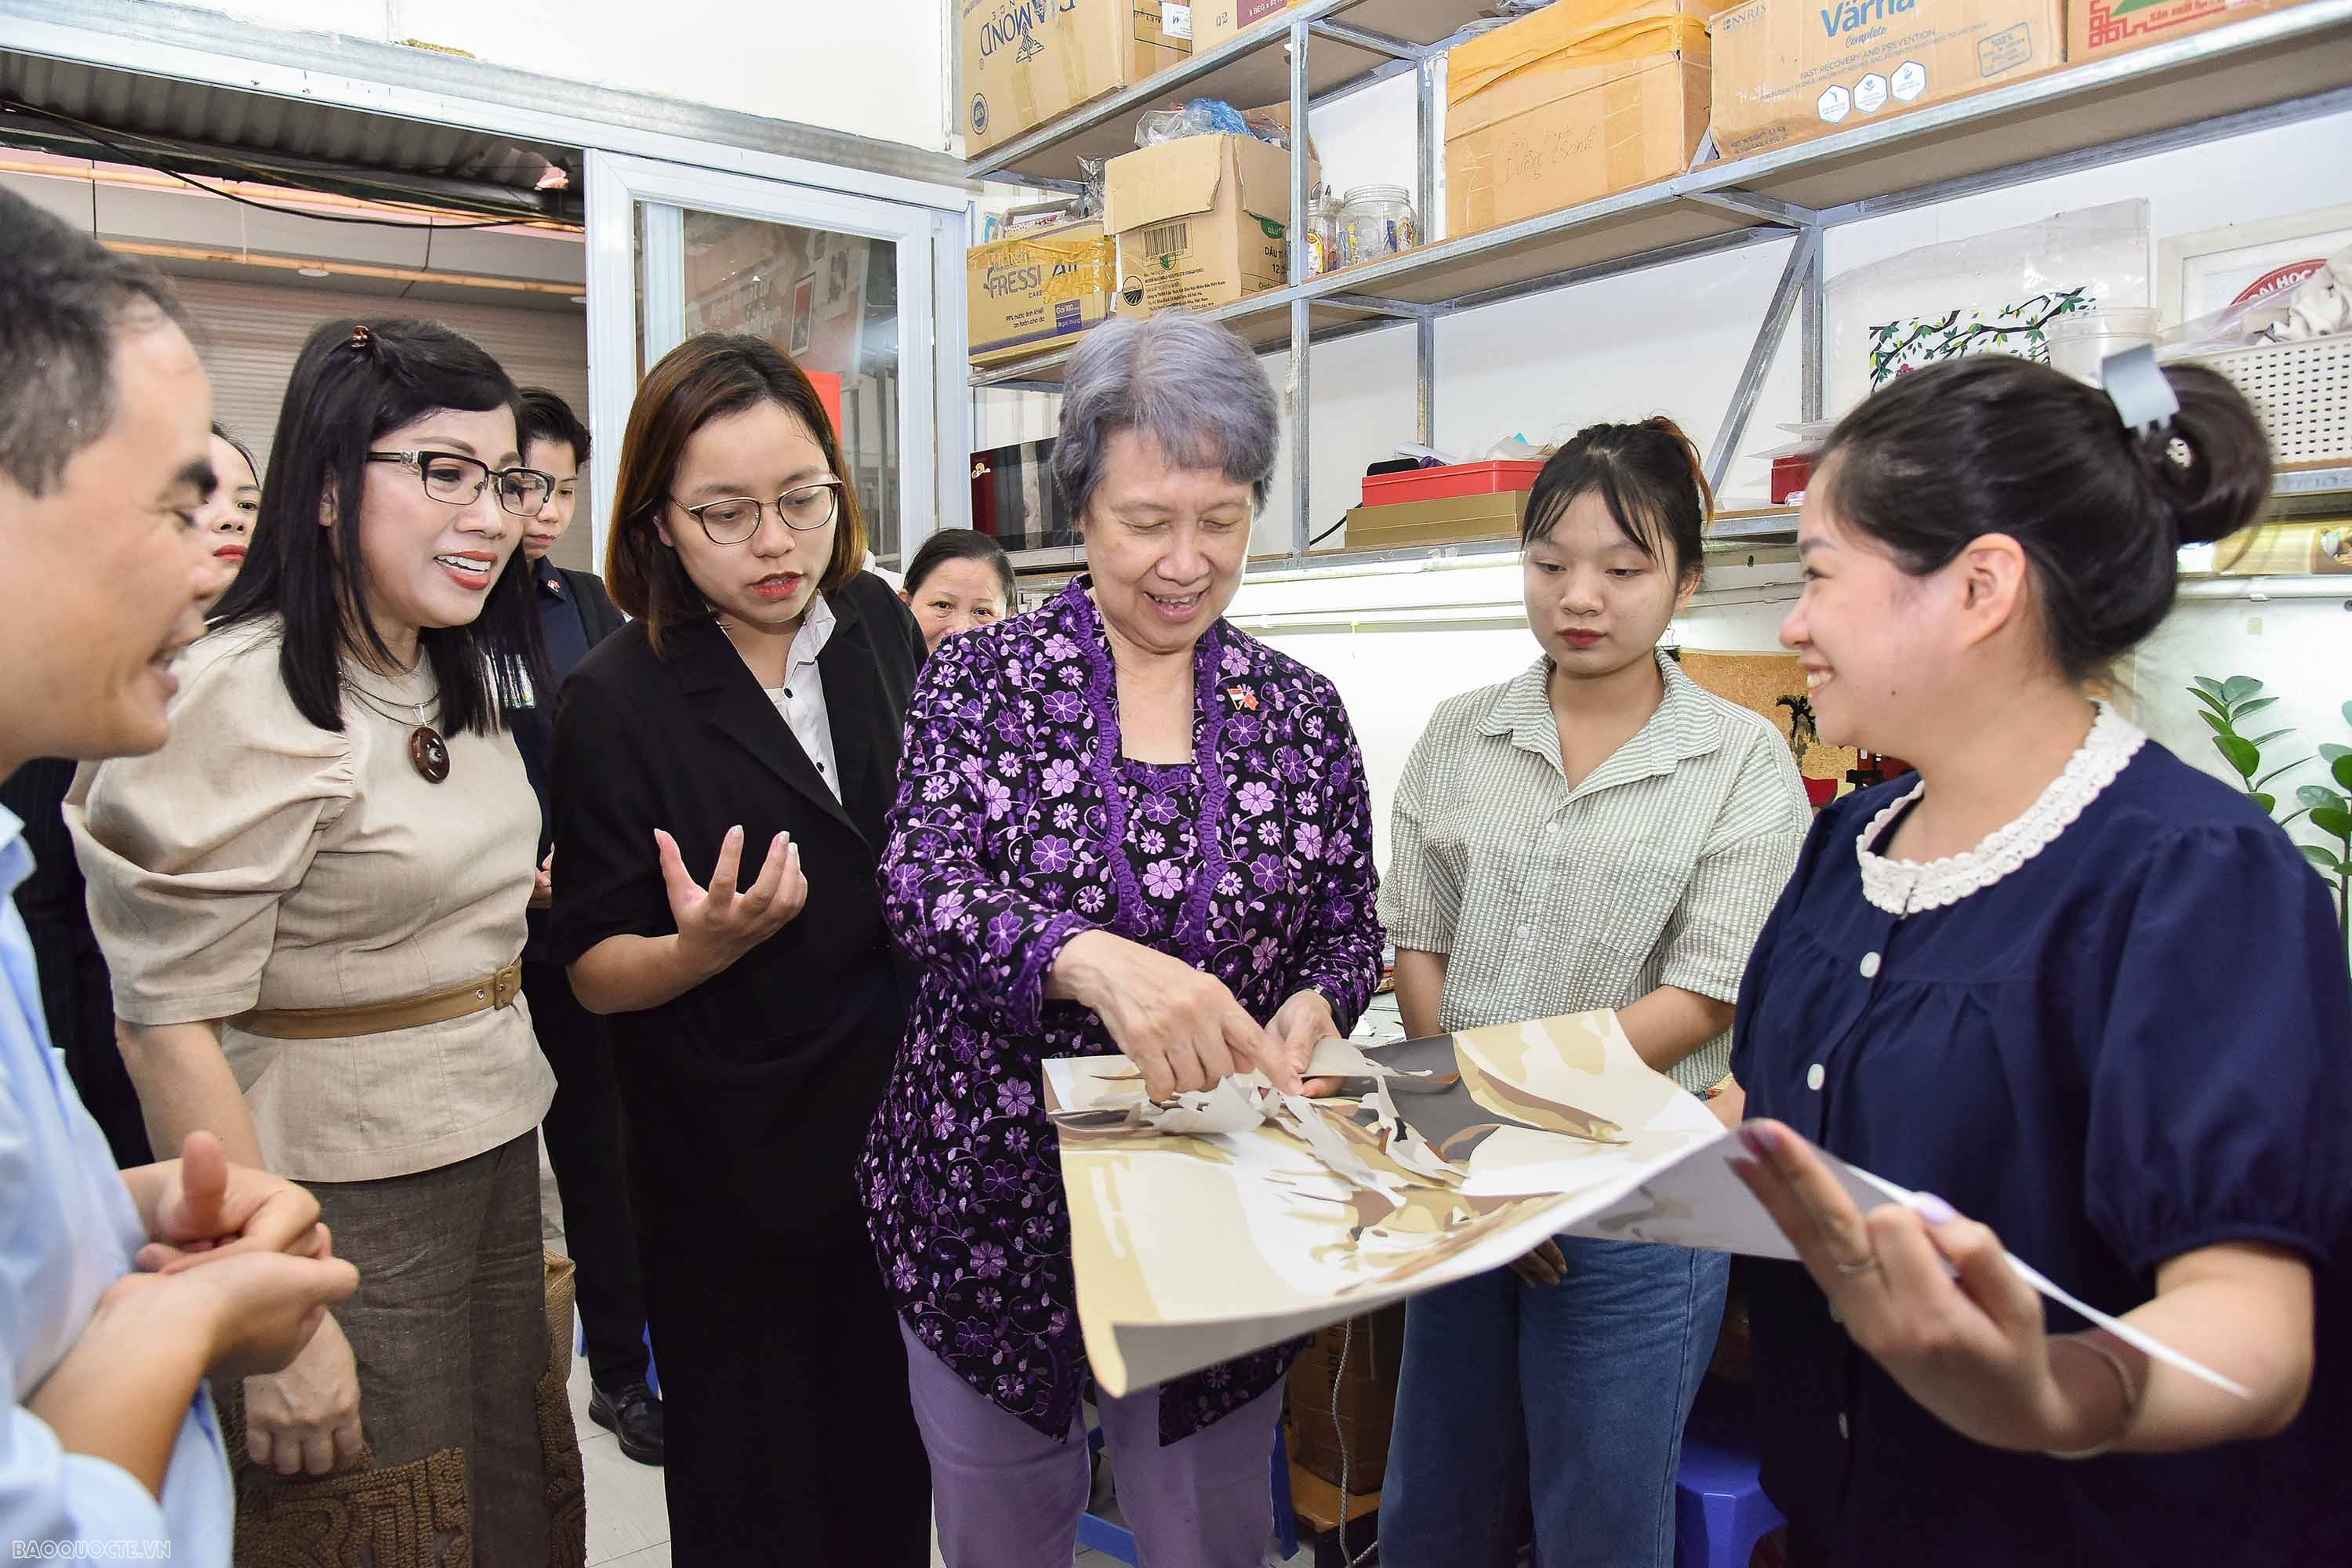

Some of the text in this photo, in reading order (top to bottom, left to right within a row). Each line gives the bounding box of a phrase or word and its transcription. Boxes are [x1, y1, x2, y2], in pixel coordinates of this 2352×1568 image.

[1844, 27, 1887, 49] Complete
[1800, 67, 1818, 80] FAST
[1819, 54, 1861, 77] RECOVERY
[1863, 45, 1881, 60] AND
[1882, 29, 1936, 53] PREVENTION
[1272, 263, 1280, 274] 12
[989, 264, 1043, 299] FRESSI
[1028, 289, 1044, 299] CARE
